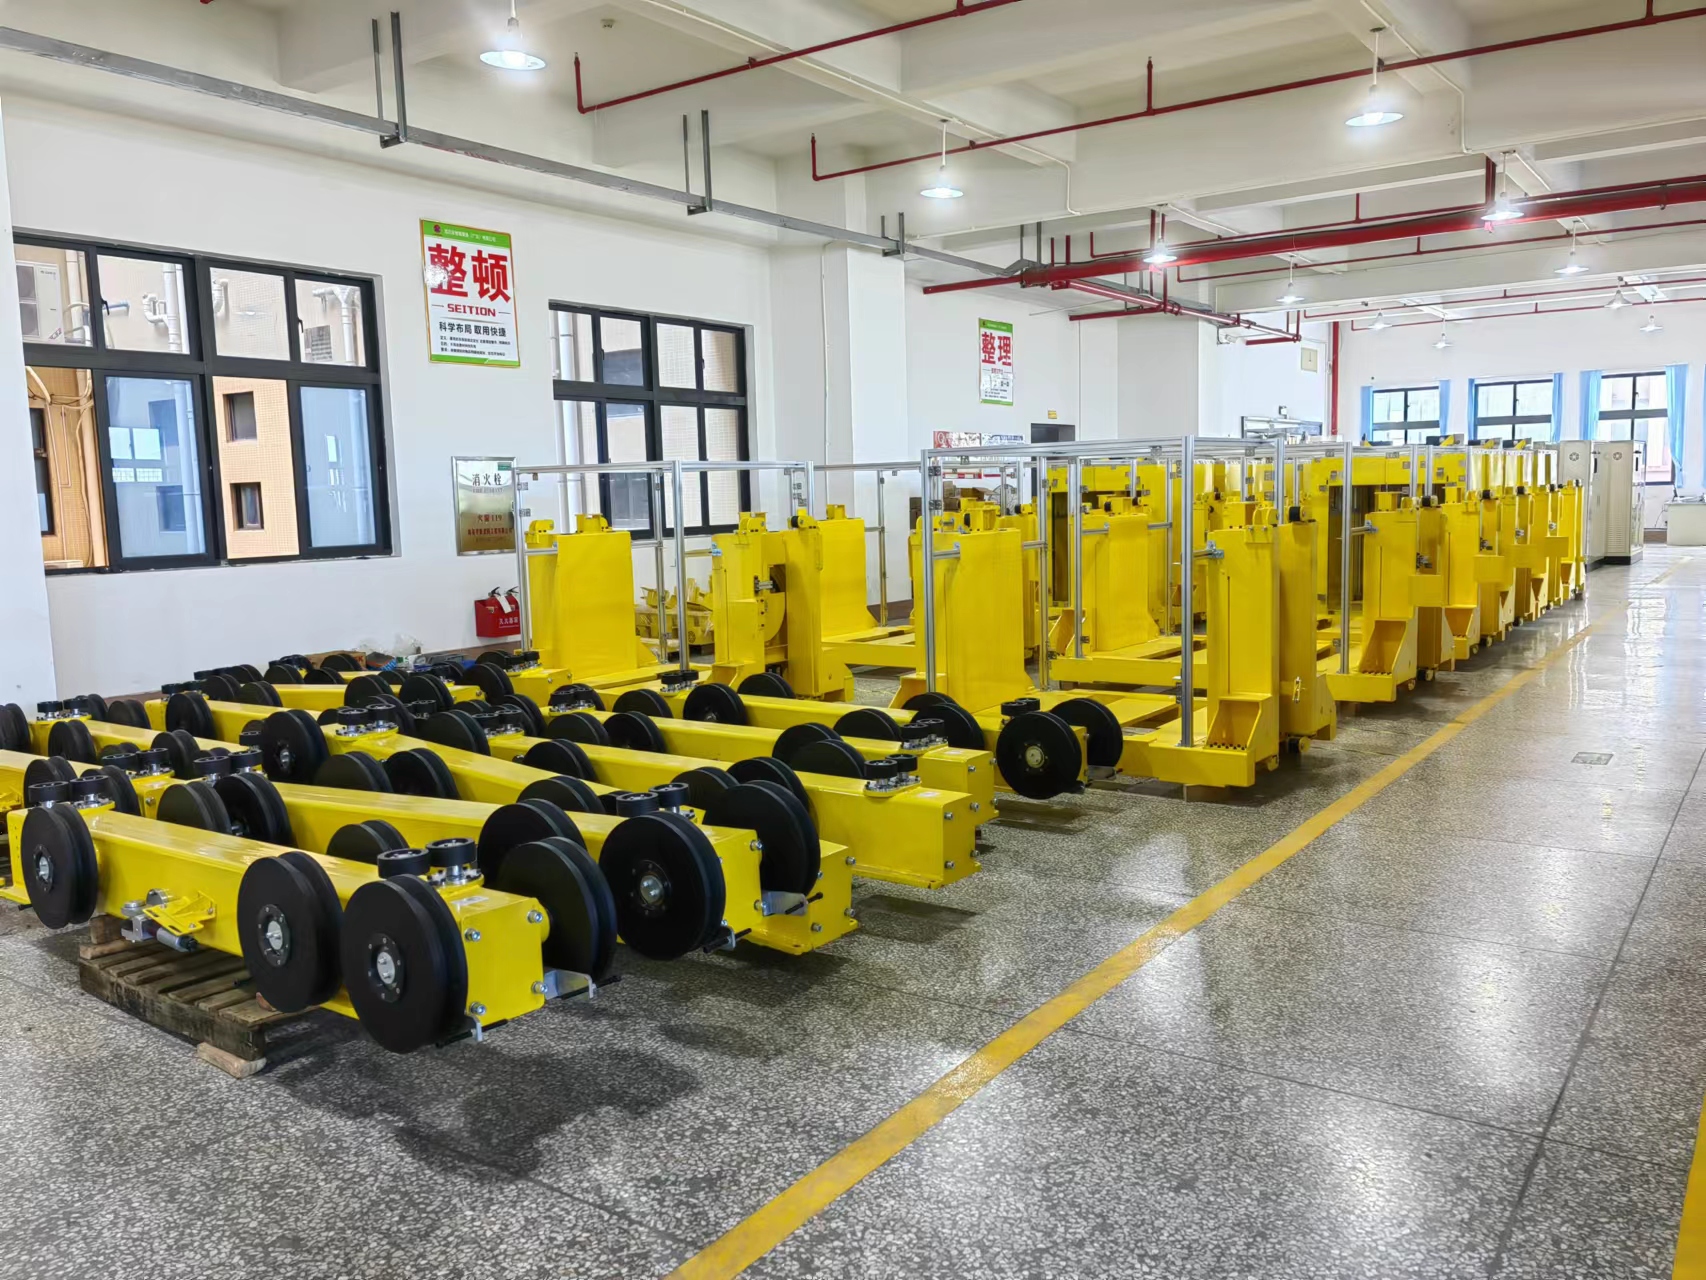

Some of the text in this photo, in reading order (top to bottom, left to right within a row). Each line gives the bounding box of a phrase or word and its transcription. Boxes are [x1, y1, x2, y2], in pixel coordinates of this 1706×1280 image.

[428, 243, 511, 303] 整顿
[447, 303, 496, 317] SEITION
[439, 321, 507, 338] 科学布局 取用快捷
[981, 331, 1012, 367] 整理
[471, 472, 501, 486] 消火栓
